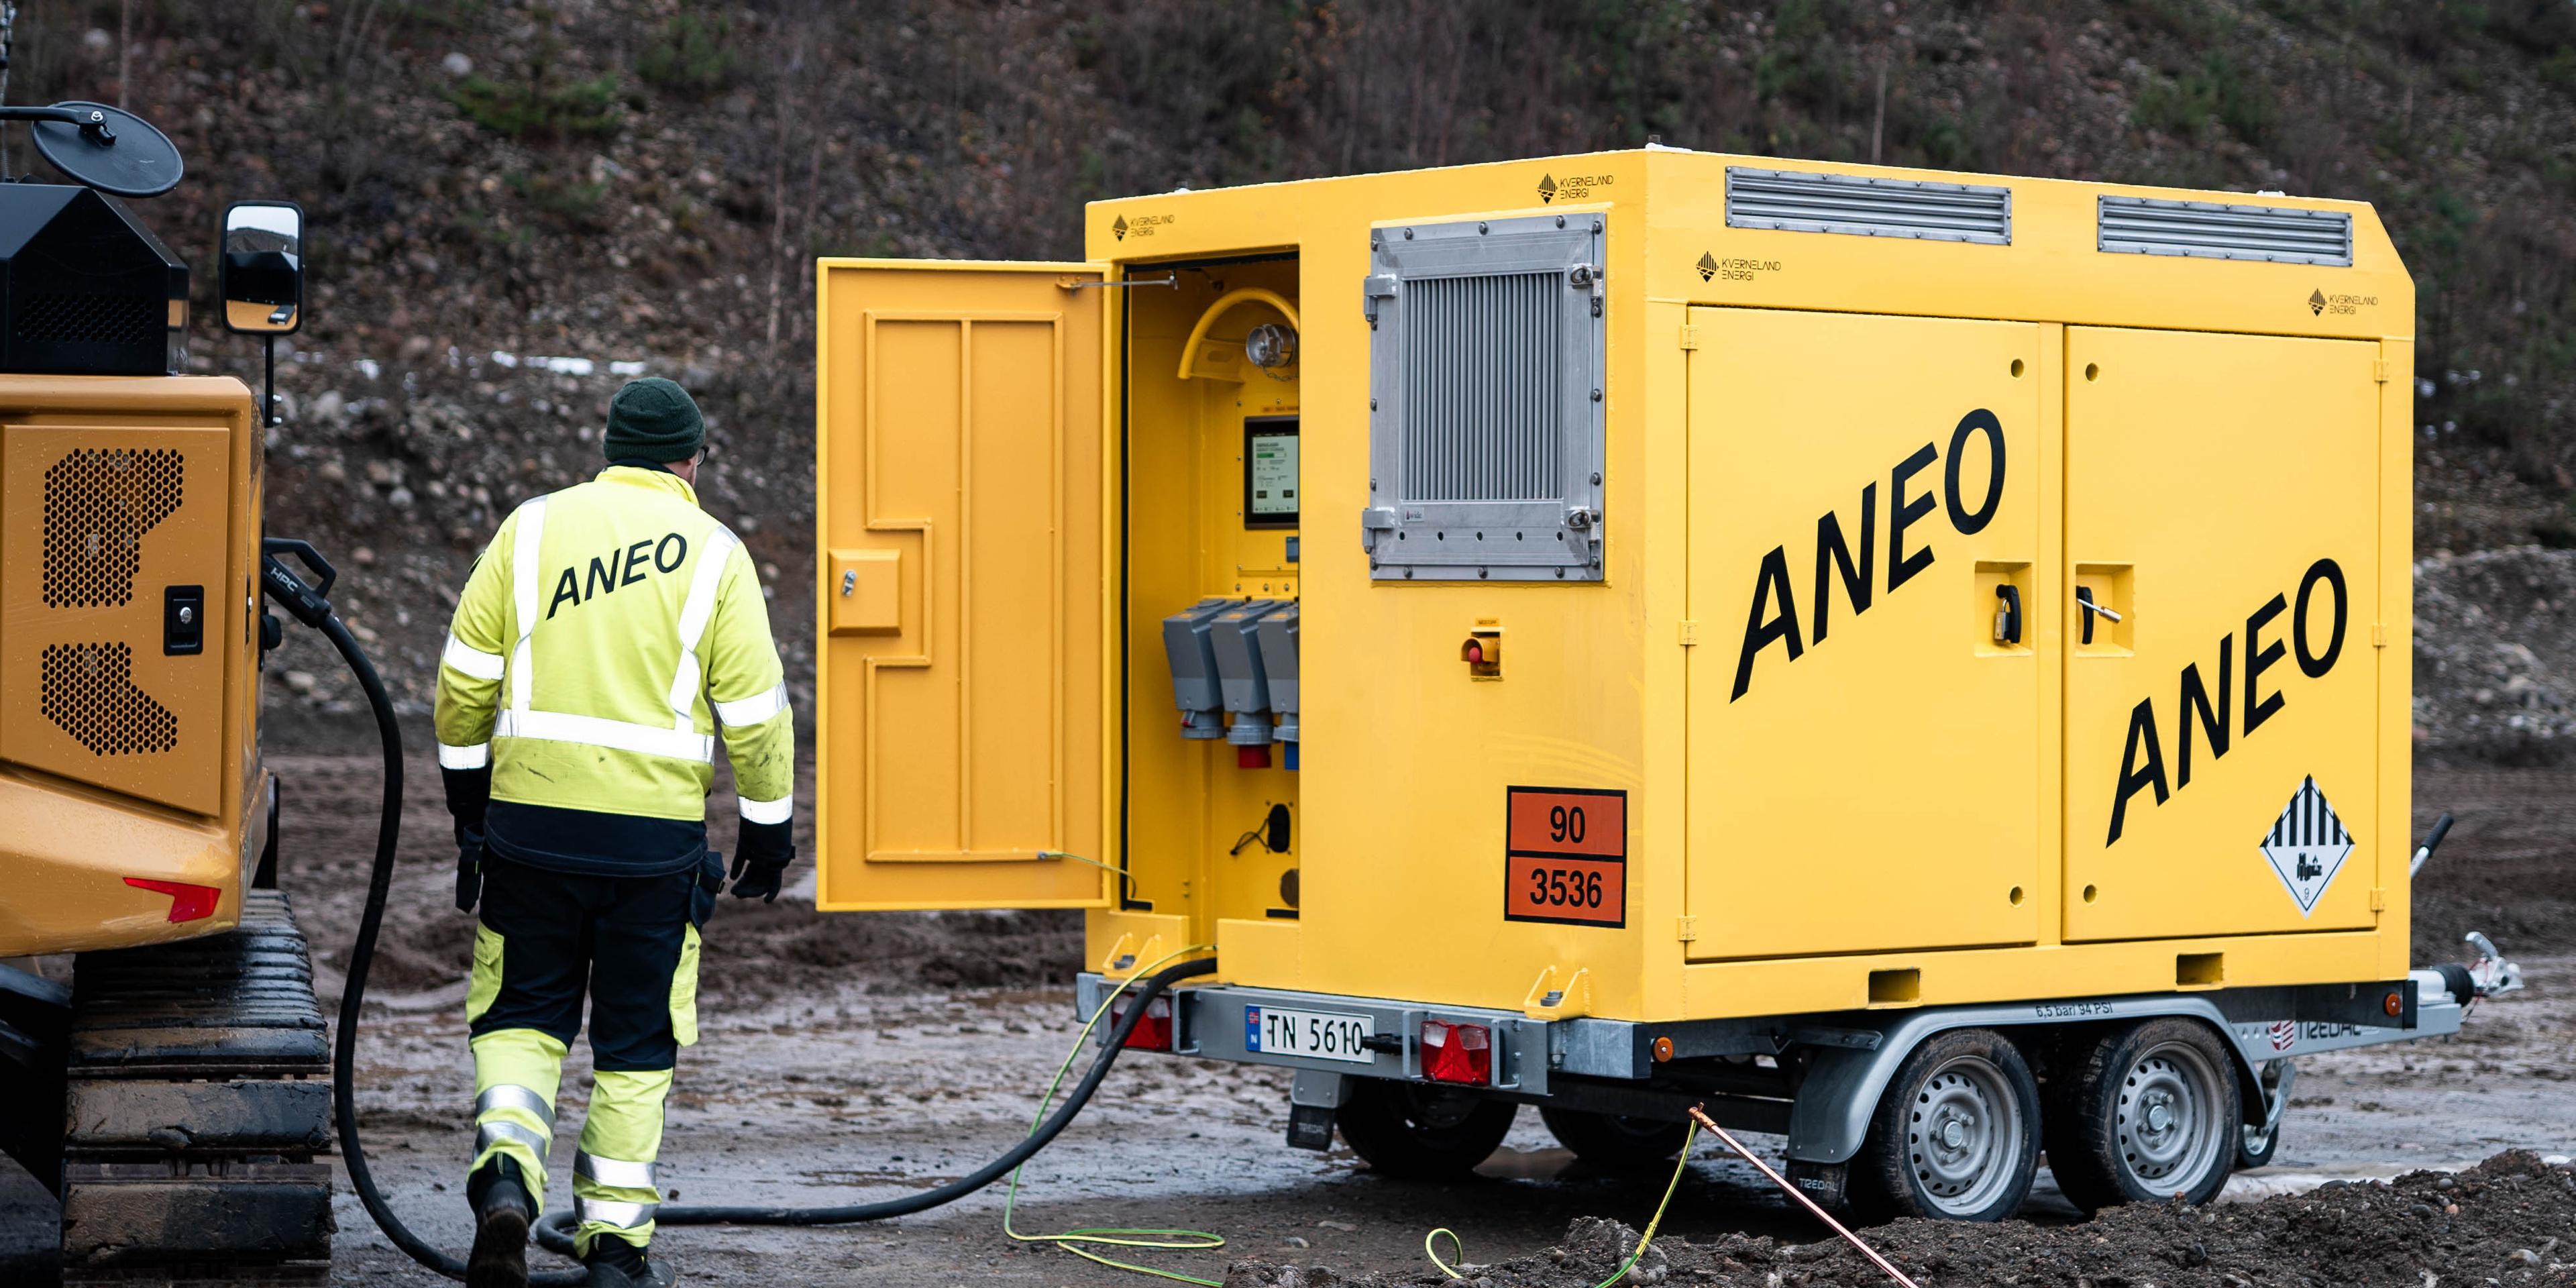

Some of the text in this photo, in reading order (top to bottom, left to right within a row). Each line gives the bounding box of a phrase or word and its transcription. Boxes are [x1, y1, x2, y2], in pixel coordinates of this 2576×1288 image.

[1560, 174, 1614, 188] KVERNELAND
[1560, 188, 1589, 199] ENERGI
[1721, 258, 1782, 271] KVERNELAND
[1721, 270, 1754, 280] ENERGI
[2329, 294, 2379, 306] KVERNELAND
[2329, 304, 2357, 315] ENERGI
[1729, 408, 2006, 704] ANEO
[270, 567, 299, 592] HPC
[545, 533, 688, 621] ANEO
[2105, 558, 2348, 849] ANEO
[1550, 805, 1586, 844] 90
[1529, 868, 1602, 909] 3536
[2304, 887, 2310, 899] 9
[2035, 1005, 2053, 1018] 6,5
[2080, 1003, 2092, 1015] 94
[2095, 1002, 2113, 1014] PSI
[1267, 1014, 1364, 1055] TN 5610
[1799, 1177, 1838, 1192] TREDAL
